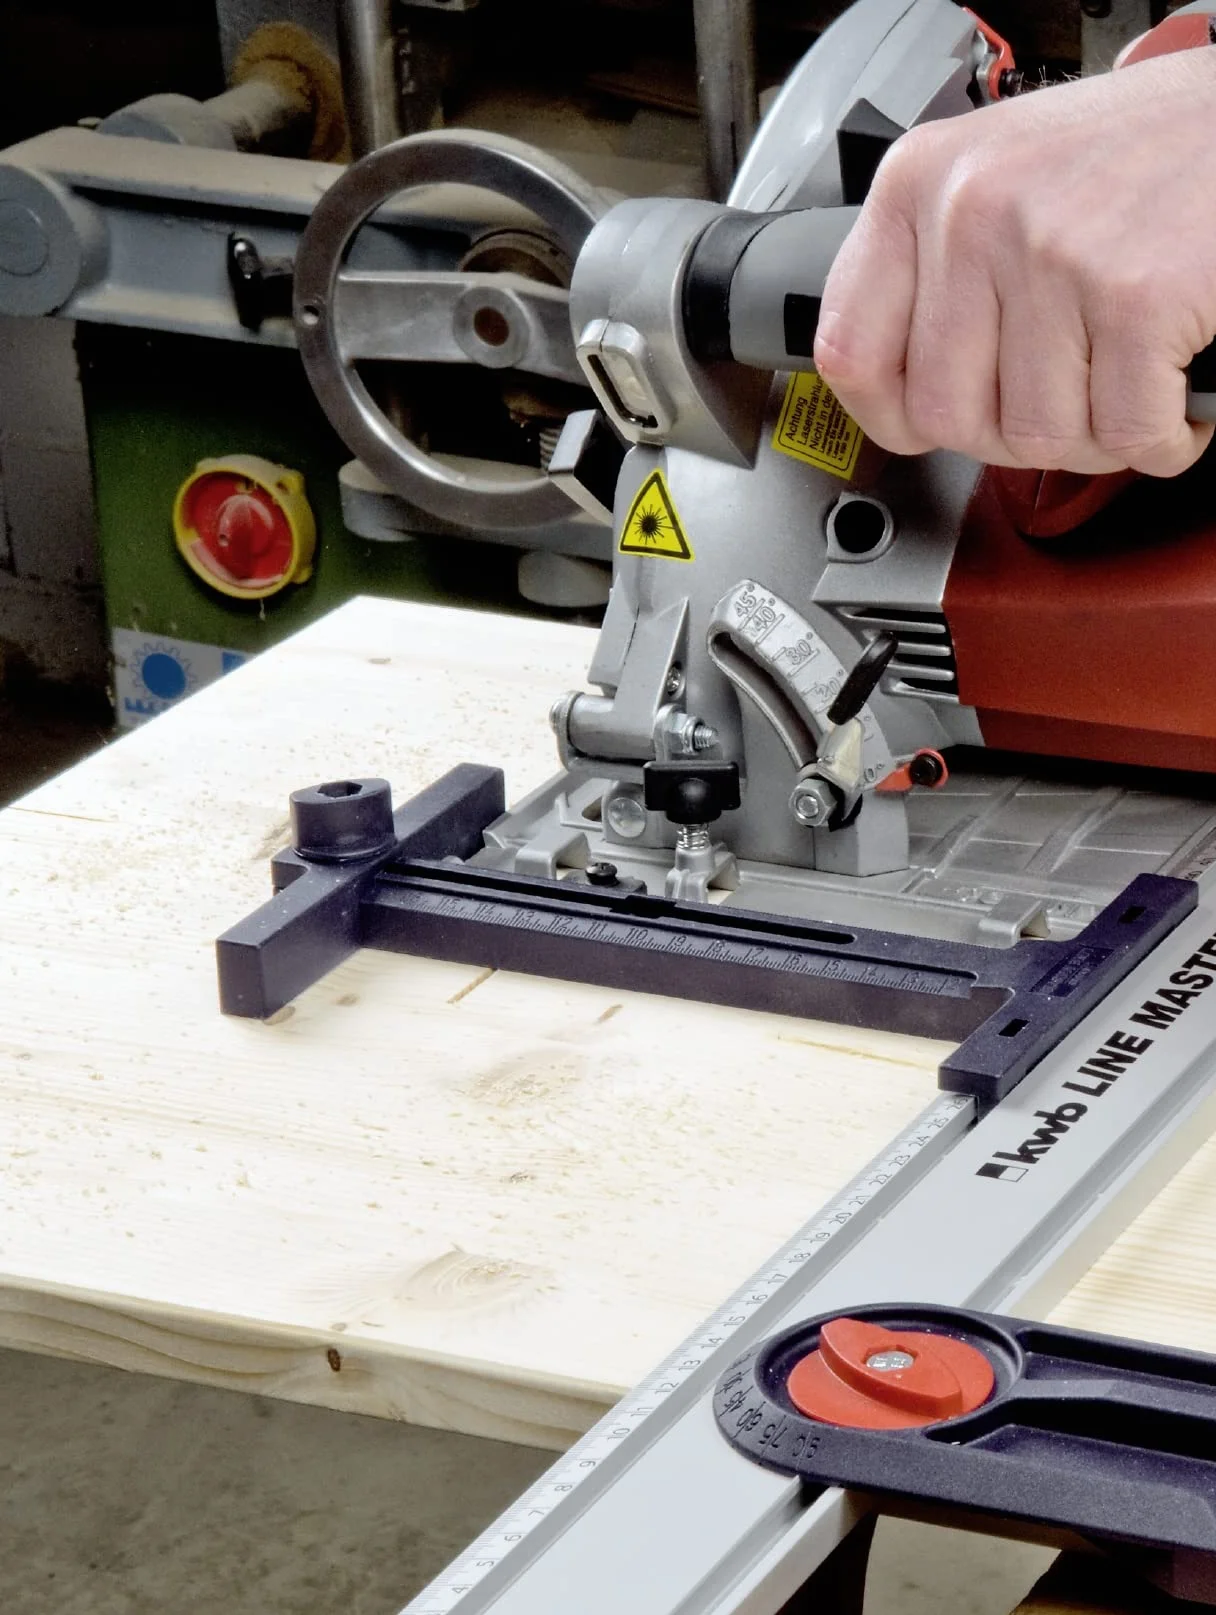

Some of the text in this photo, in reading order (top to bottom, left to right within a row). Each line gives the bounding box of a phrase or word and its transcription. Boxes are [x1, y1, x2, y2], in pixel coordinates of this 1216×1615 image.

[786, 396, 808, 441] Achtung
[809, 421, 826, 450] Nicht
[820, 410, 829, 421] in
[991, 1102, 1088, 1164] kwb
[1061, 1030, 1154, 1098] LINE
[829, 1212, 852, 1225] 20
[810, 1232, 831, 1244] 19
[789, 1252, 811, 1264] 18
[768, 1273, 788, 1285] 17
[746, 1293, 768, 1306] 16
[724, 1315, 746, 1327] 15
[701, 1336, 723, 1350] 14
[678, 1359, 701, 1371] 13
[655, 1382, 679, 1395] 12
[631, 1406, 654, 1418] 11
[606, 1427, 631, 1441] 10
[578, 1460, 596, 1468] 9
[554, 1483, 573, 1493] 8
[528, 1509, 545, 1518] 7
[503, 1534, 522, 1543] 6
[476, 1560, 495, 1569] 5
[451, 1586, 469, 1595] 4
